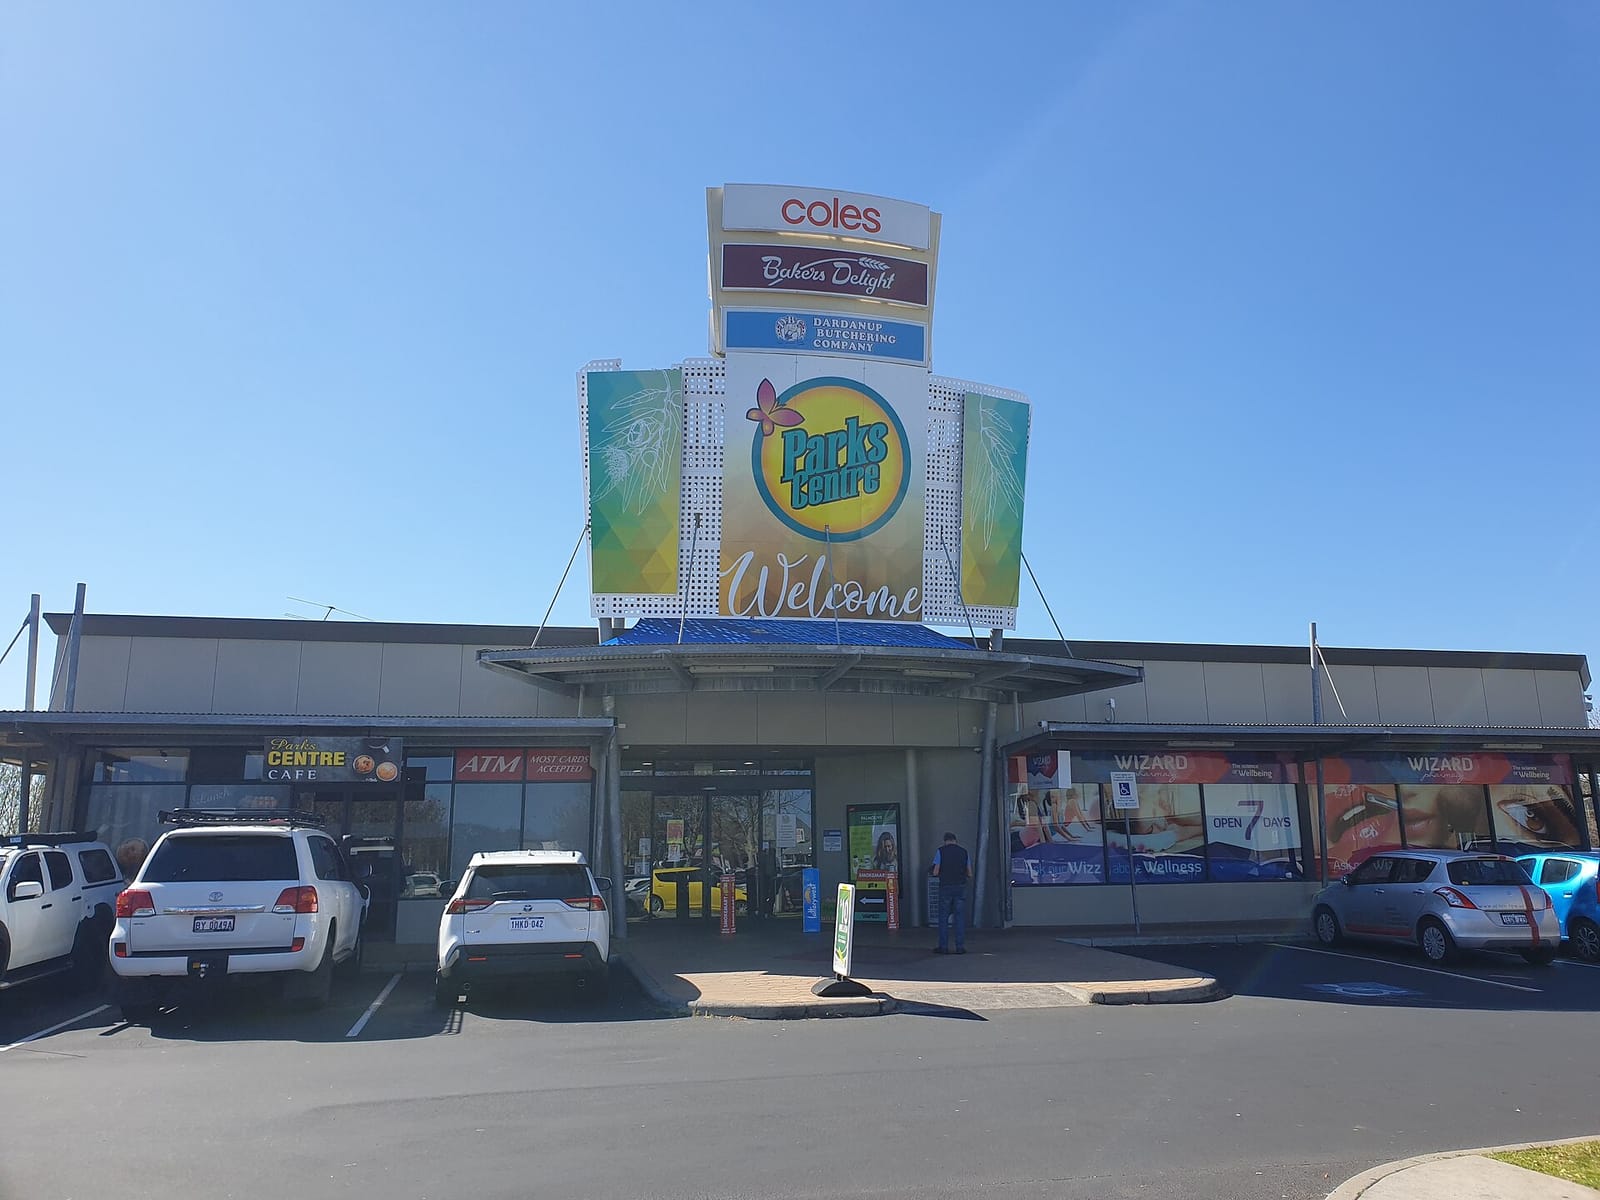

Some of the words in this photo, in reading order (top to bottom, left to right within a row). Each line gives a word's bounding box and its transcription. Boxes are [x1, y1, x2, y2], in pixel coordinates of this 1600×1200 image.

[781, 197, 882, 234] coles
[761, 255, 826, 283] Bakers
[831, 261, 896, 295] Delight
[813, 317, 883, 332] DARDANUP
[816, 328, 897, 344] BUTCHERING
[813, 339, 874, 352] COMPANY
[780, 415, 889, 484] Parks
[790, 462, 881, 510] Centre
[719, 550, 922, 619] Welcome
[270, 738, 317, 751] Parks
[267, 751, 345, 767] CENTRE
[458, 755, 522, 773] ATM
[530, 755, 557, 764] MOST
[557, 755, 590, 764] CARDS
[1113, 754, 1188, 771] WIZARD
[1407, 756, 1474, 771] WIZARD
[267, 769, 317, 780] CAFE
[537, 765, 583, 773] ACCEPTED
[1239, 769, 1273, 779] Wellbeing
[1519, 770, 1550, 780] Wellbeing
[1213, 817, 1243, 828] OPEN
[1237, 799, 1264, 841] 7
[1263, 816, 1292, 828] DAYS
[1067, 861, 1101, 875] Wizz
[1143, 860, 1202, 874] Wellness
[807, 883, 819, 919] lotterywest
